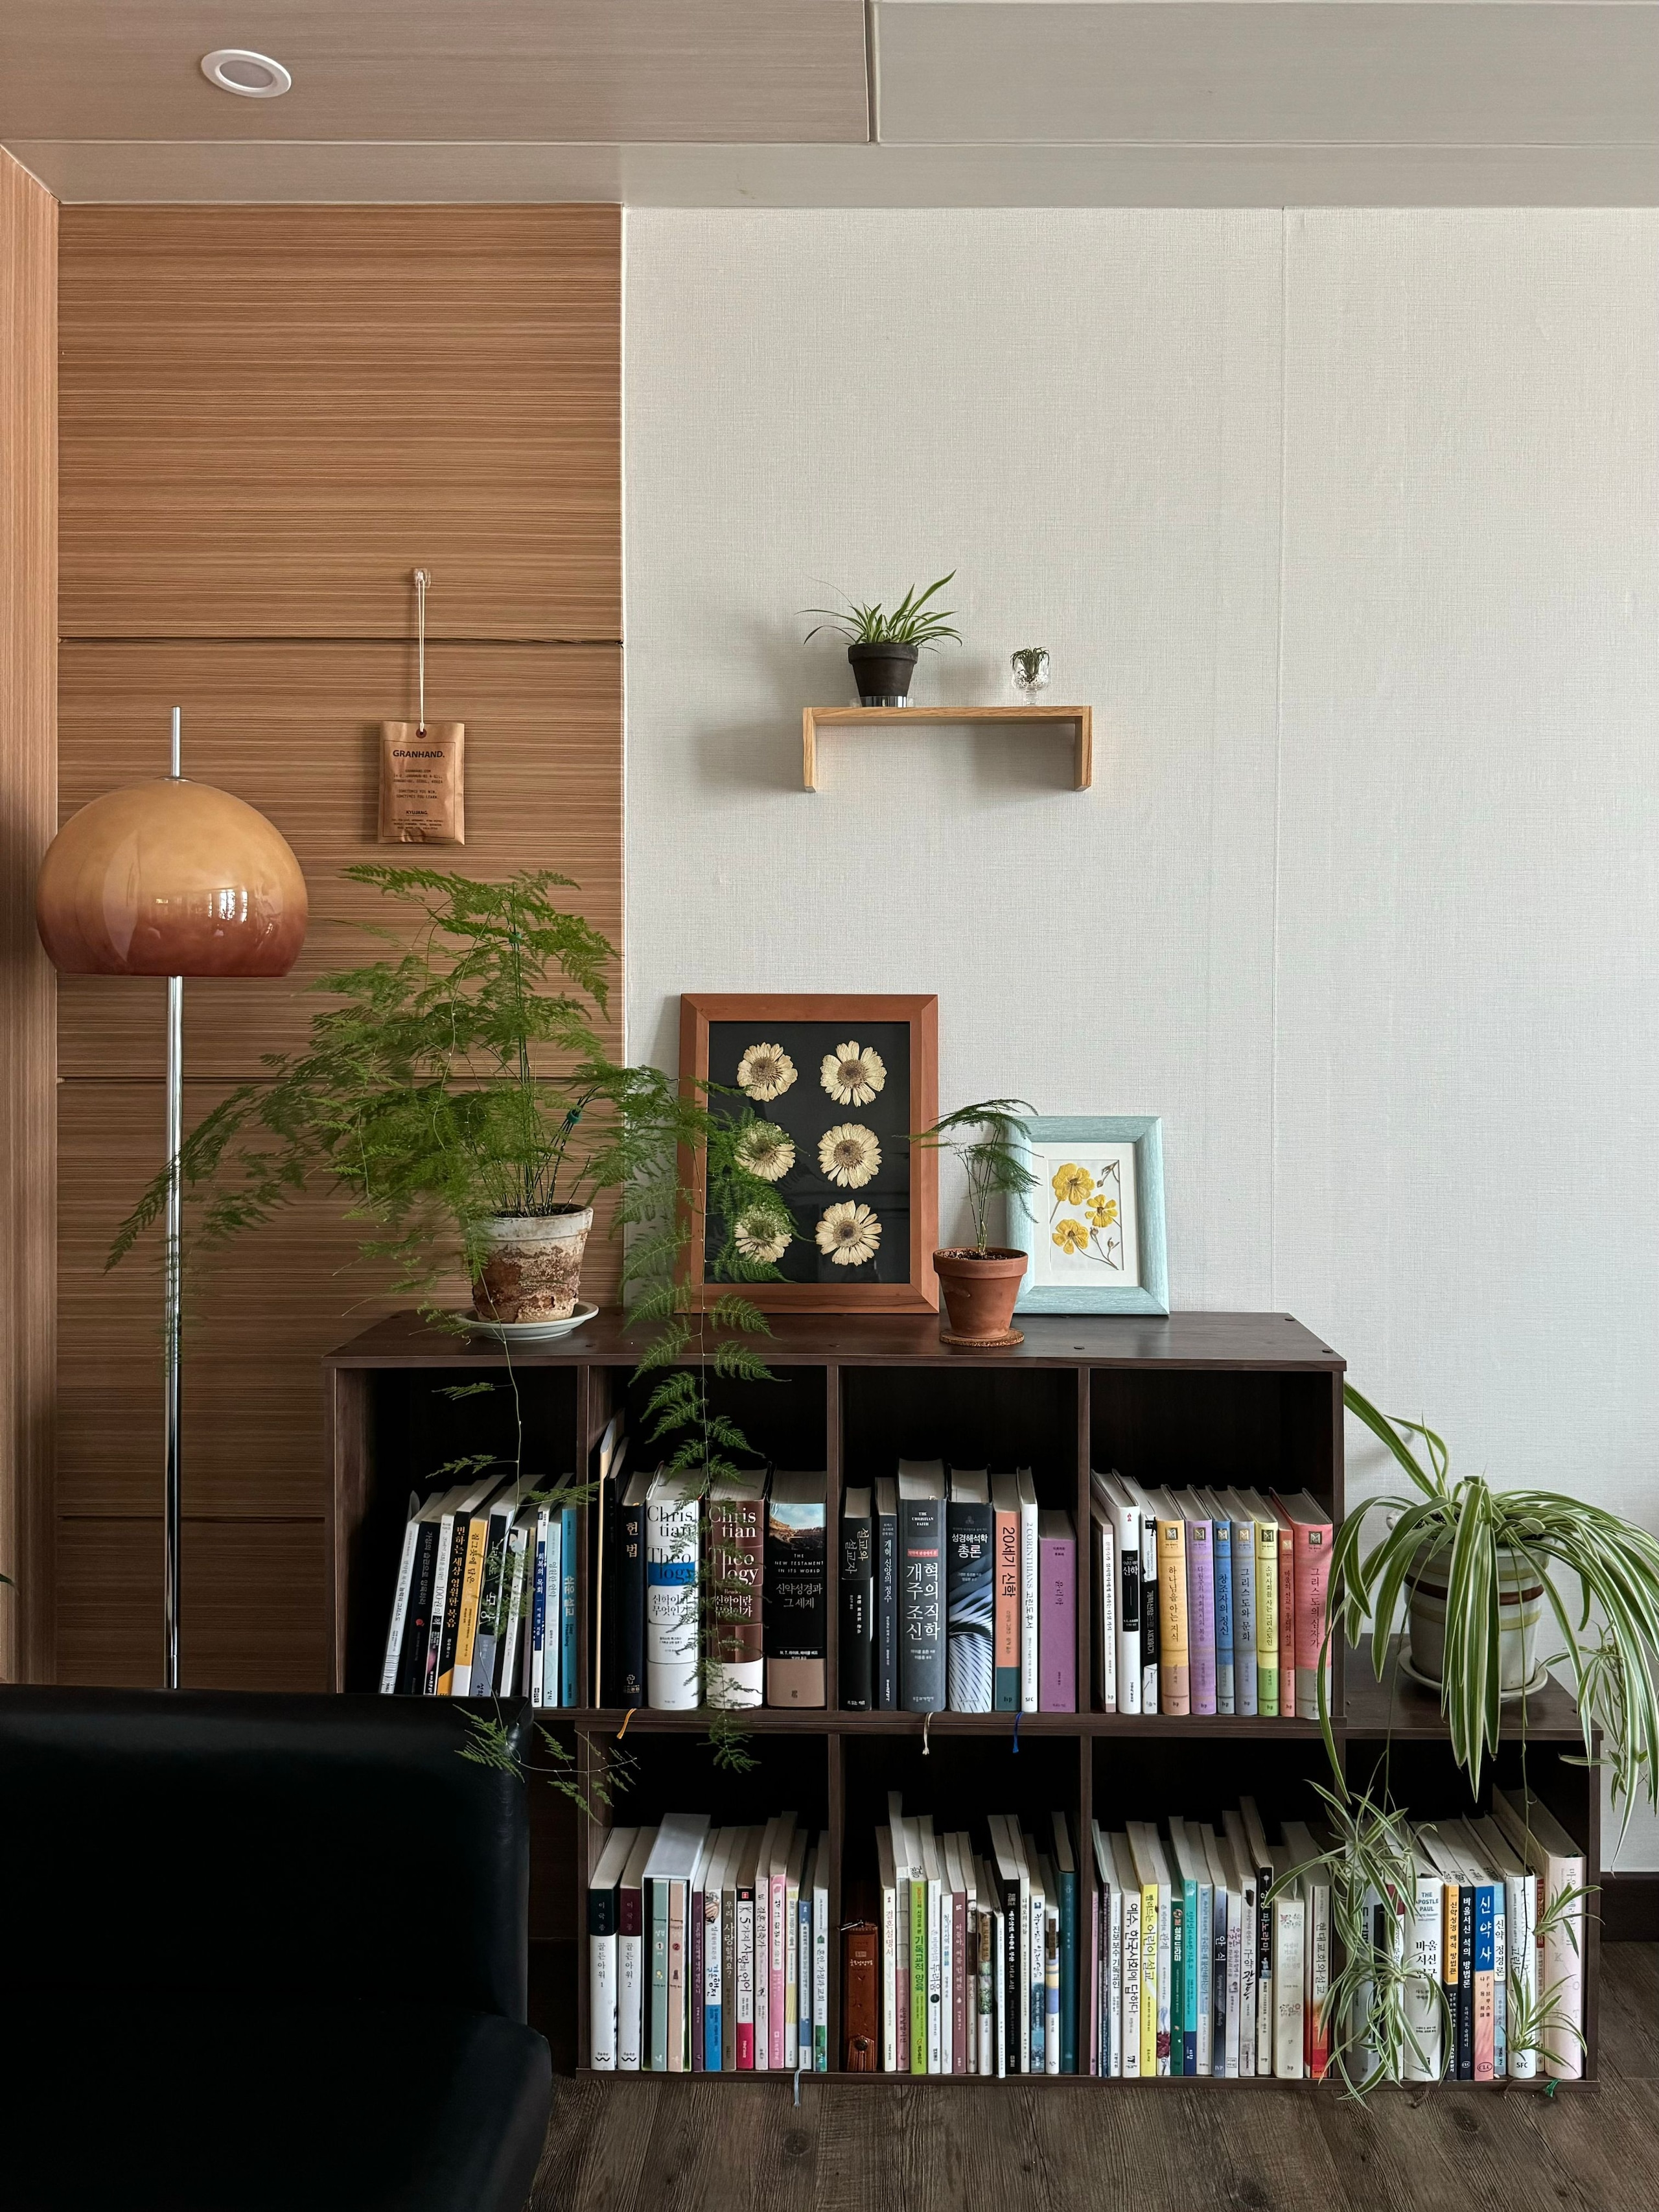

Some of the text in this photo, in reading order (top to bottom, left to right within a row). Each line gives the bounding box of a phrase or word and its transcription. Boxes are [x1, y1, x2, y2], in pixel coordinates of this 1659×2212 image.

[393, 750, 445, 758] GRANHAND.
[648, 1505, 693, 1522] Chris
[721, 1524, 756, 1538] tian
[857, 1527, 869, 1561] 설교와
[952, 1533, 988, 1543] 성경해석학
[844, 1539, 857, 1574] 설교자
[958, 1544, 982, 1558] 총론
[1002, 1527, 1016, 1597] 20세기 신학
[907, 1563, 939, 1581] 개혁
[1122, 1565, 1139, 1576] 신학
[564, 1576, 575, 1616] 쉬운 설교
[776, 1583, 823, 1596] 신약성경과
[795, 1597, 815, 1609] 세계
[907, 1582, 939, 1601] 주의
[1168, 1566, 1179, 1642] 하나님을 아는 지식
[907, 1603, 939, 1622] 조직
[1025, 1591, 1034, 1629] 고린도후서
[1219, 1574, 1229, 1635] 창조자의 정신
[1240, 1568, 1251, 1641] 그리스도와 문화
[1310, 1568, 1320, 1649] 그리스도의 십자가
[907, 1623, 940, 1640] 신학
[723, 1901, 735, 1979] 우리 사랑할까요?
[1143, 1924, 1155, 1956] 어린이
[1260, 1913, 1270, 1951] 파노라마
[1415, 1940, 1438, 1951] 바울
[1462, 1897, 1471, 1988] 바울서신 석의 방법론
[737, 1916, 752, 1992] 5가지 사랑의 언어
[1124, 1903, 1138, 2014] 예수, 한국사회에 답하다
[1417, 1954, 1437, 1966] 서신
[1495, 1920, 1505, 1977] 신약 정경론
[817, 1966, 825, 1985] 가정과
[915, 1935, 925, 1992] 기독교적 양육
[930, 1963, 939, 1992] 두려움
[1144, 1959, 1155, 1982] 설교
[817, 1987, 825, 2001] 교회
